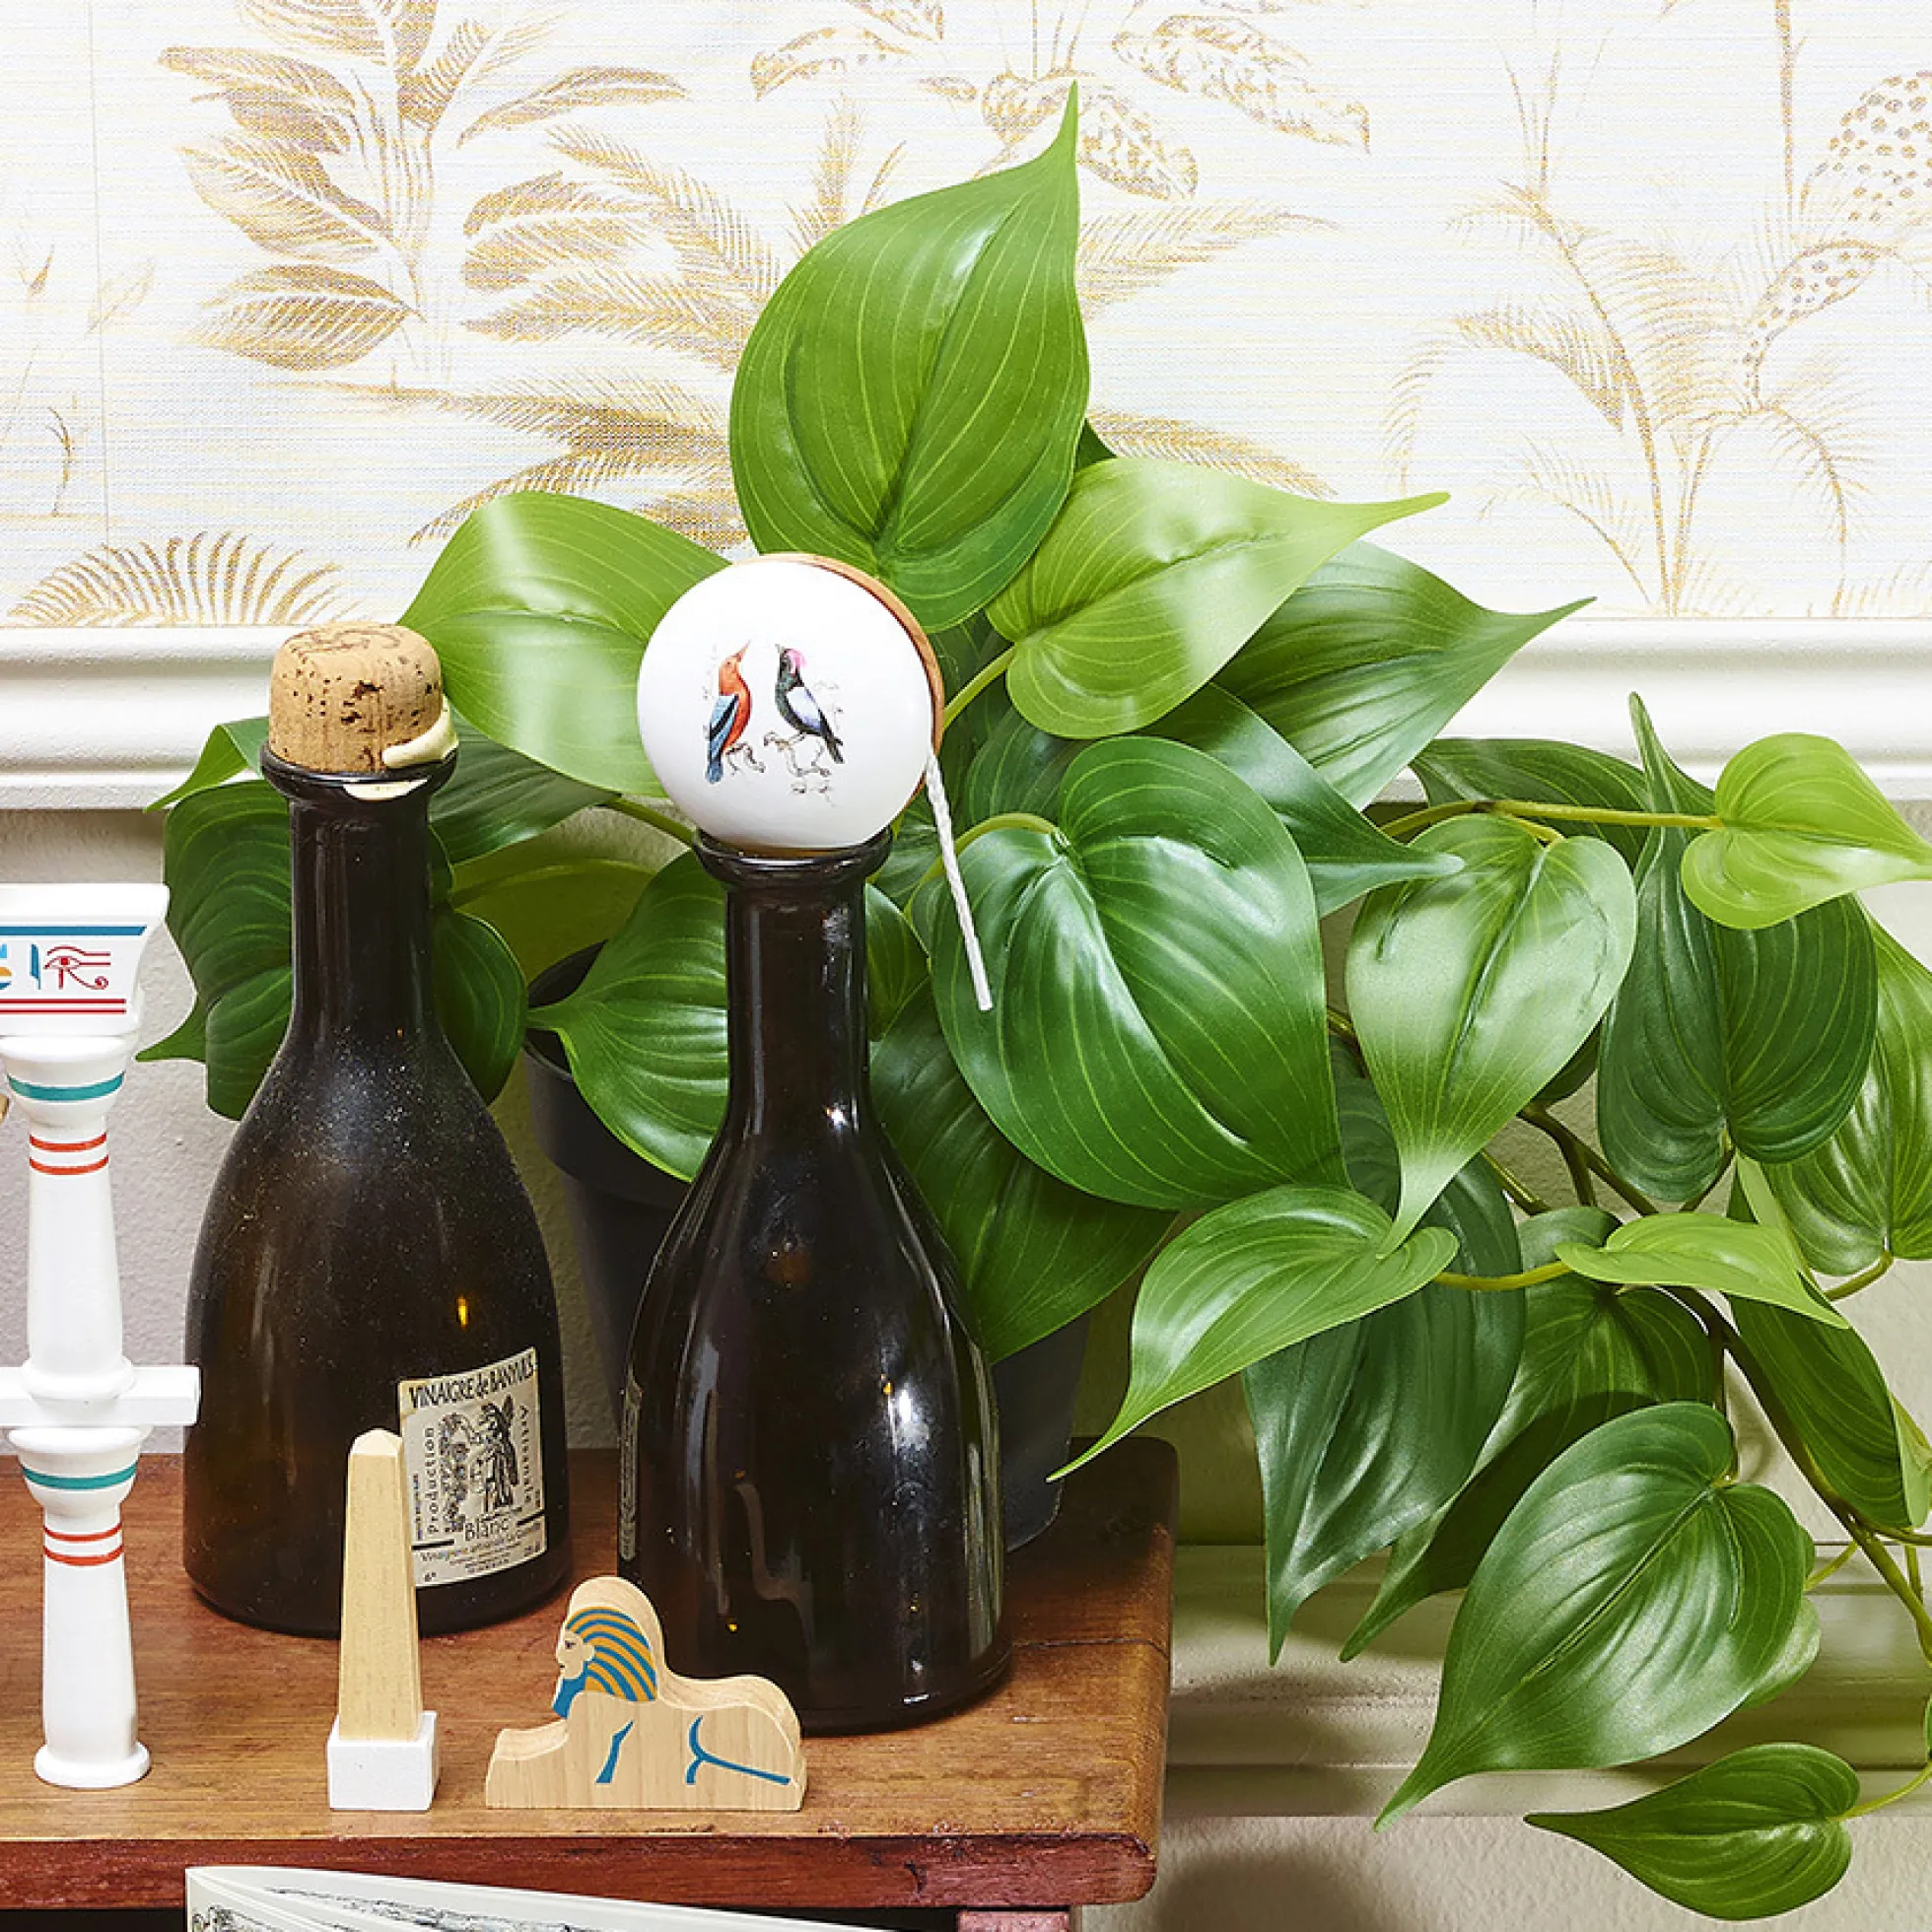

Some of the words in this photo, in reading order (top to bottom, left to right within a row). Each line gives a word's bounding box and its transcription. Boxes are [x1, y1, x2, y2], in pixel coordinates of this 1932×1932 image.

[408, 1378, 475, 1409] VINAIGRE
[476, 1372, 490, 1398] de
[424, 1427, 440, 1535] Production
[464, 1516, 511, 1542] Blanc
